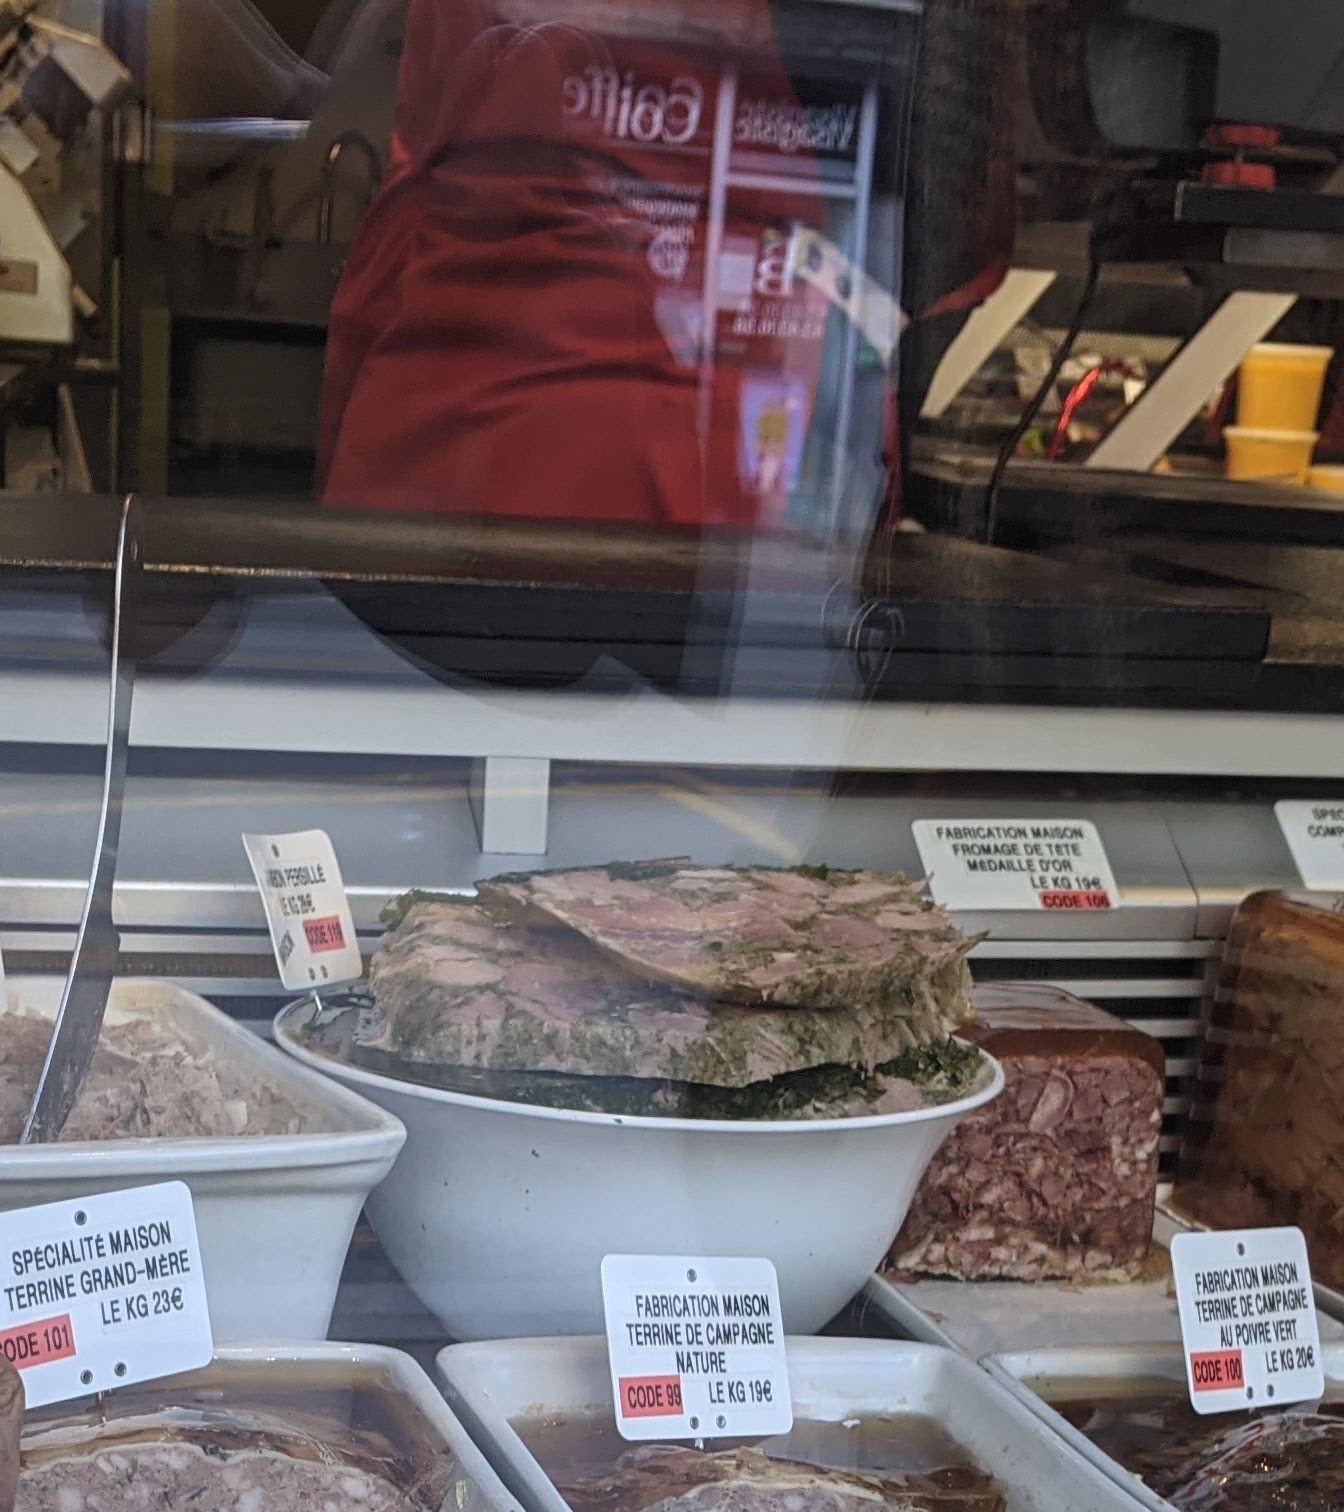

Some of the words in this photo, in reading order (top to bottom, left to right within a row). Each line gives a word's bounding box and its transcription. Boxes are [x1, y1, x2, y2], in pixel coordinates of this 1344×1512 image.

[936, 826, 1028, 840] FABRICATION
[1030, 826, 1084, 840] MAISON
[952, 843, 1021, 857] FROMAGE
[1023, 843, 1044, 857] DE
[1039, 859, 1074, 873] D'OR
[1030, 876, 1048, 890] LE
[1052, 877, 1072, 890] KG
[1041, 894, 1084, 908] CODE
[11, 1233, 107, 1277] SPÉCIALITÉ
[108, 1220, 172, 1256] MAISON
[4, 1273, 77, 1312] TERRINE
[80, 1249, 191, 1295] GRAND-MÈRE
[1194, 1264, 1260, 1297] FABRICATION
[1260, 1262, 1299, 1287] MAISON
[101, 1299, 122, 1325] LE
[126, 1294, 149, 1321] KG
[152, 1286, 185, 1315] 23€
[635, 1294, 719, 1318] FABRICATION
[721, 1294, 771, 1318] MAISON
[1194, 1296, 1240, 1324] TERRINE
[1240, 1293, 1255, 1318] DE
[1255, 1287, 1309, 1316] CAMPAGNE
[43, 1323, 71, 1351] 101
[625, 1322, 683, 1347] TERRINE
[685, 1322, 704, 1346] DE
[706, 1322, 775, 1346] CAMPAGNE
[1220, 1324, 1233, 1348] AU
[1235, 1320, 1272, 1347] POIVRE
[1272, 1318, 1298, 1343] VERT
[675, 1351, 727, 1375] NATURE
[1193, 1358, 1222, 1384] CODE
[1224, 1356, 1242, 1382] 100
[1265, 1351, 1279, 1374] LE
[1280, 1348, 1295, 1373] KG
[1296, 1345, 1316, 1370] 20€
[627, 1385, 663, 1410] CODE
[666, 1383, 682, 1408] 99
[708, 1381, 726, 1405] LE
[728, 1380, 746, 1404] KG
[748, 1379, 774, 1404] 19€
